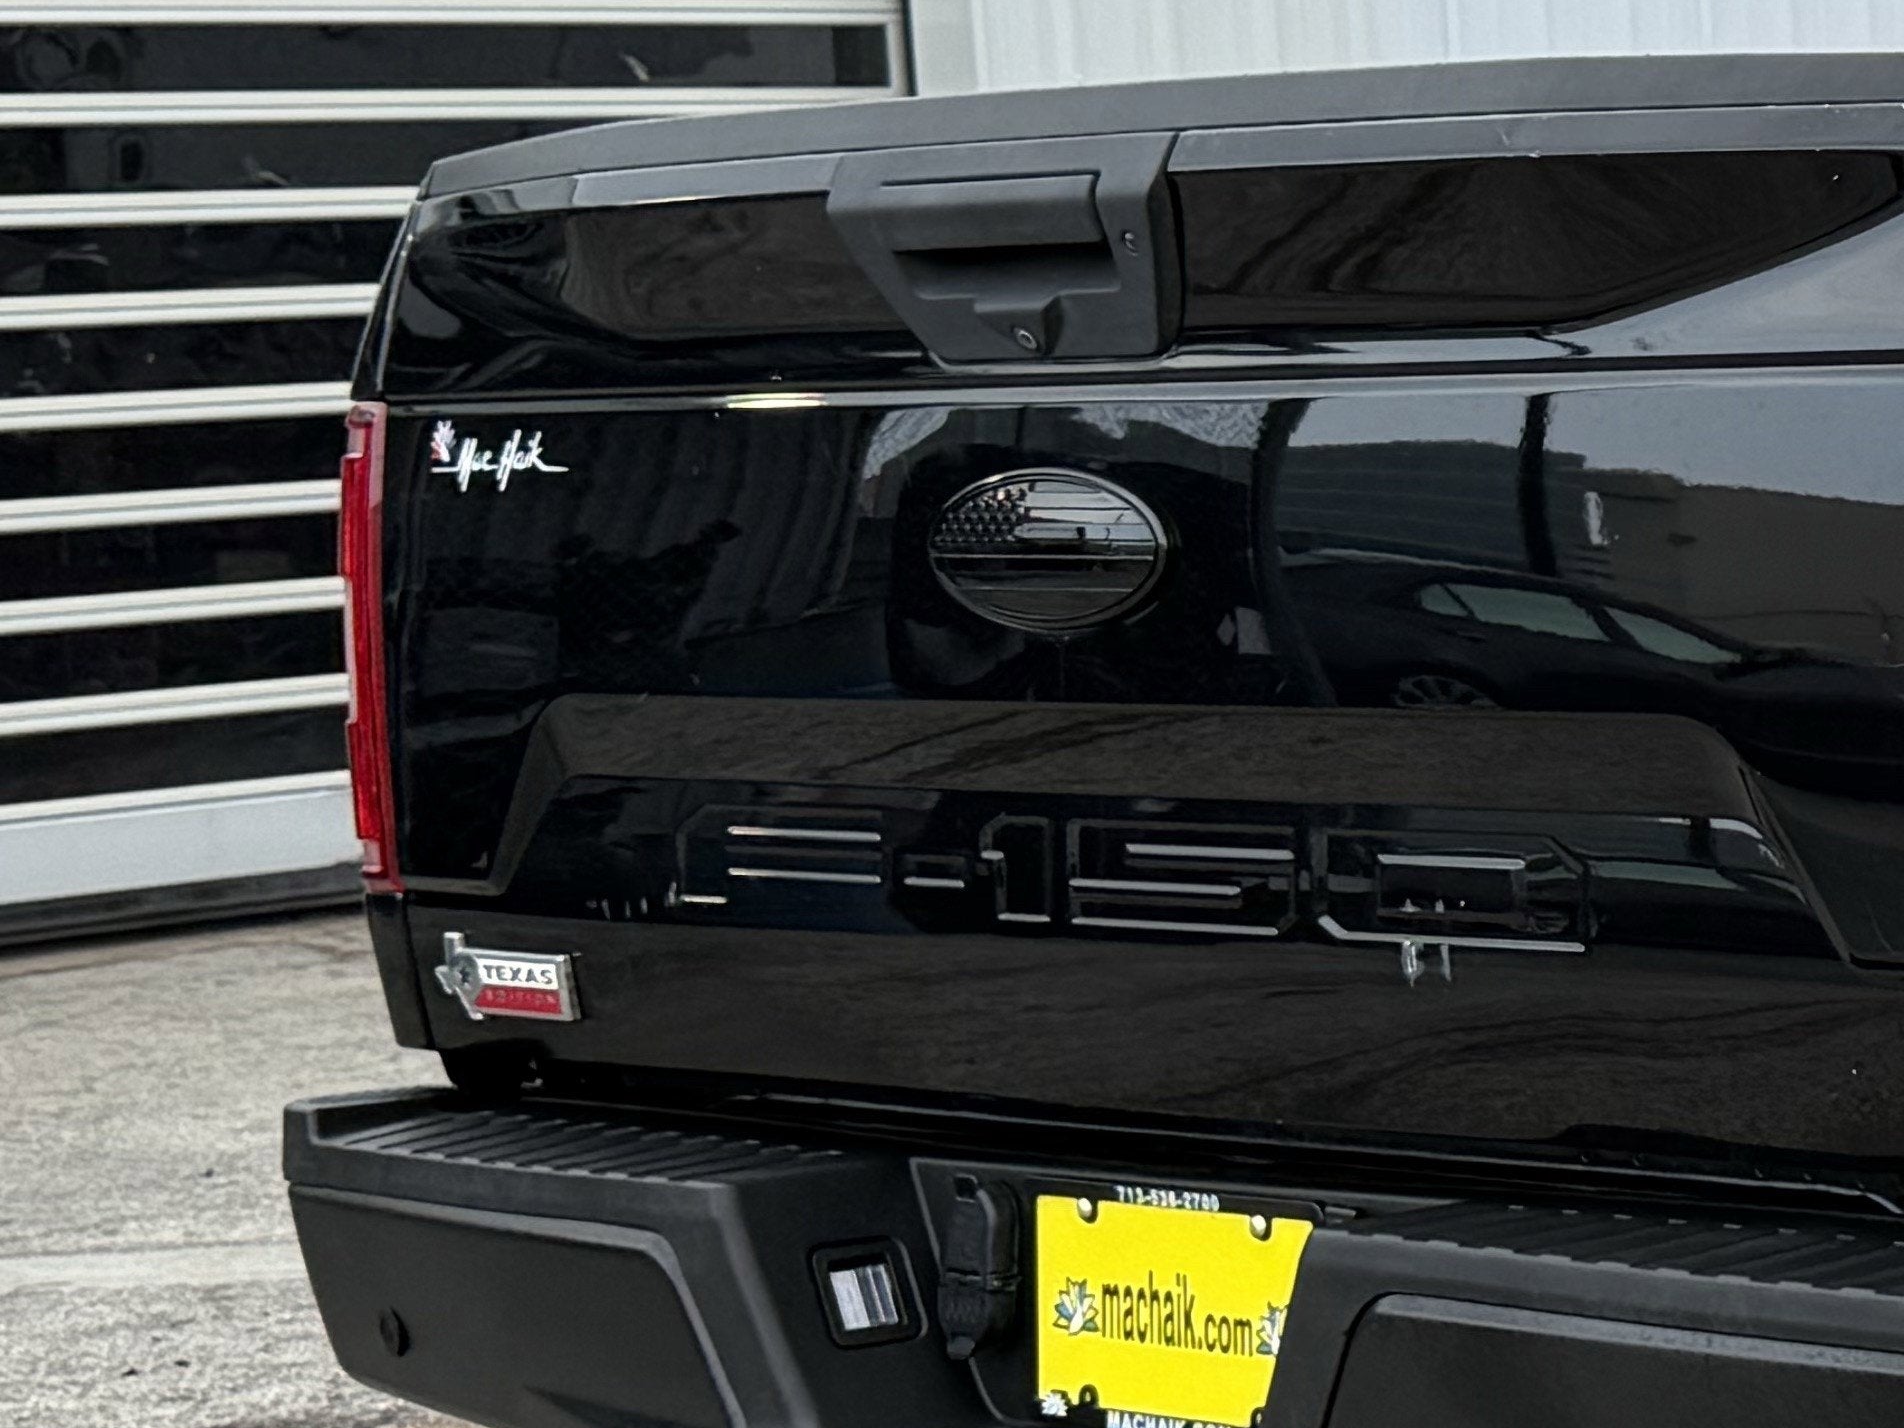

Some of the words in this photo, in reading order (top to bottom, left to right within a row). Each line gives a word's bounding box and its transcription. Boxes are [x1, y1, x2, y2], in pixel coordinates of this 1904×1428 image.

[667, 802, 1594, 952] F-150
[483, 964, 553, 985] TEXAS
[1101, 1270, 1253, 1357] machaik.com
